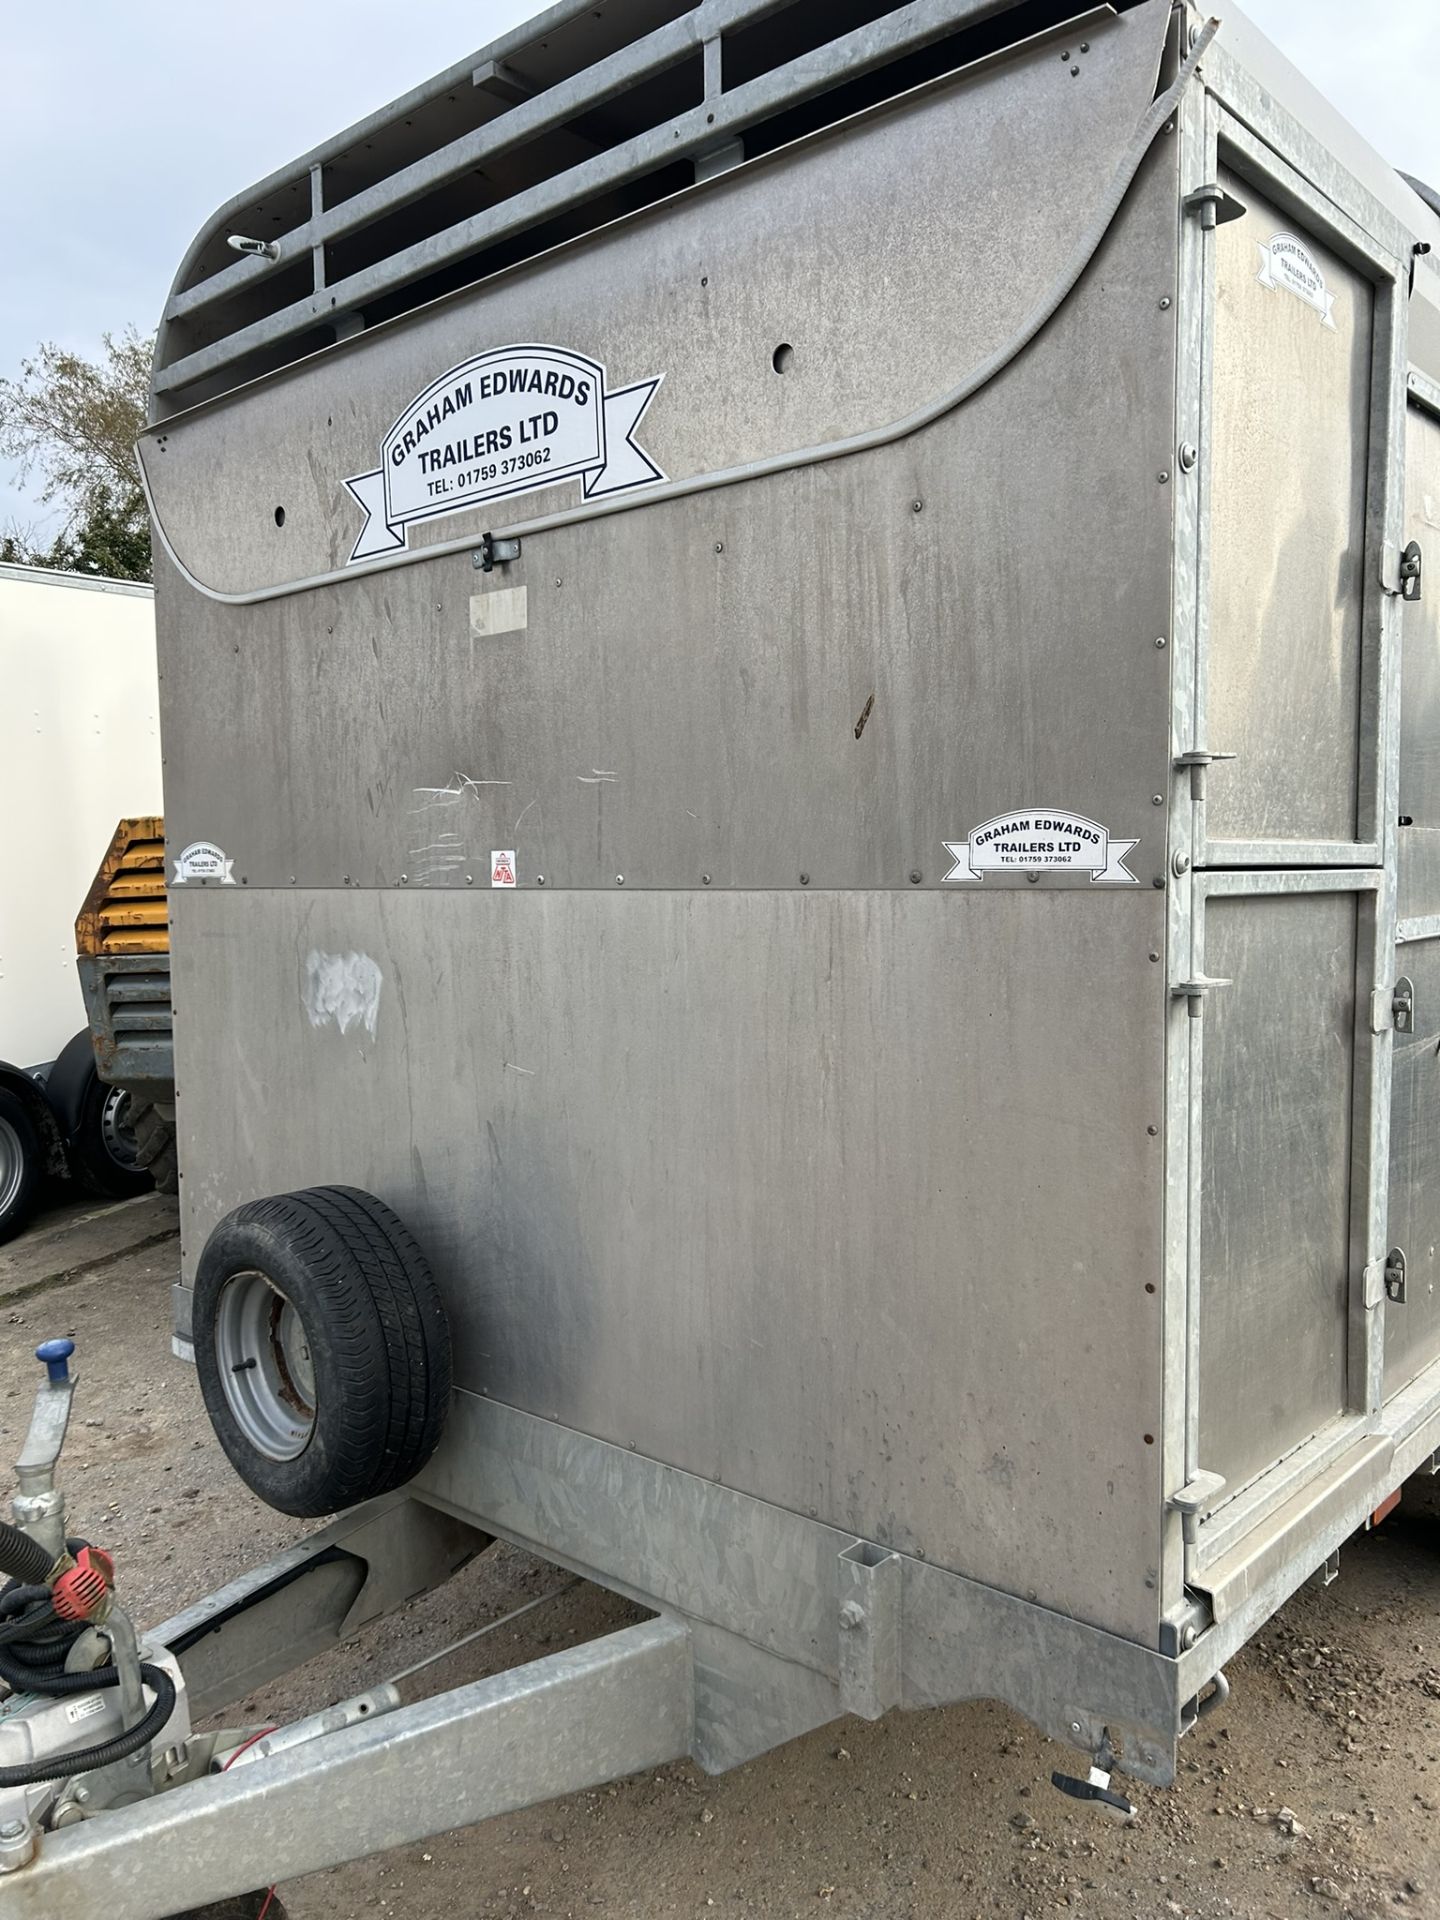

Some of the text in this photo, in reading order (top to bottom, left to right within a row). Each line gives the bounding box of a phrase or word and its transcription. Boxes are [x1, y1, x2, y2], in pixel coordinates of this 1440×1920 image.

[391, 368, 591, 467] GRAHAM EDWARDS
[418, 411, 559, 475] TRAILERS LTD
[427, 447, 551, 497] TEL: 01759 373062
[975, 820, 1101, 846] GRAHAM EDWARDS
[993, 842, 1081, 853] TRAILERS LTD
